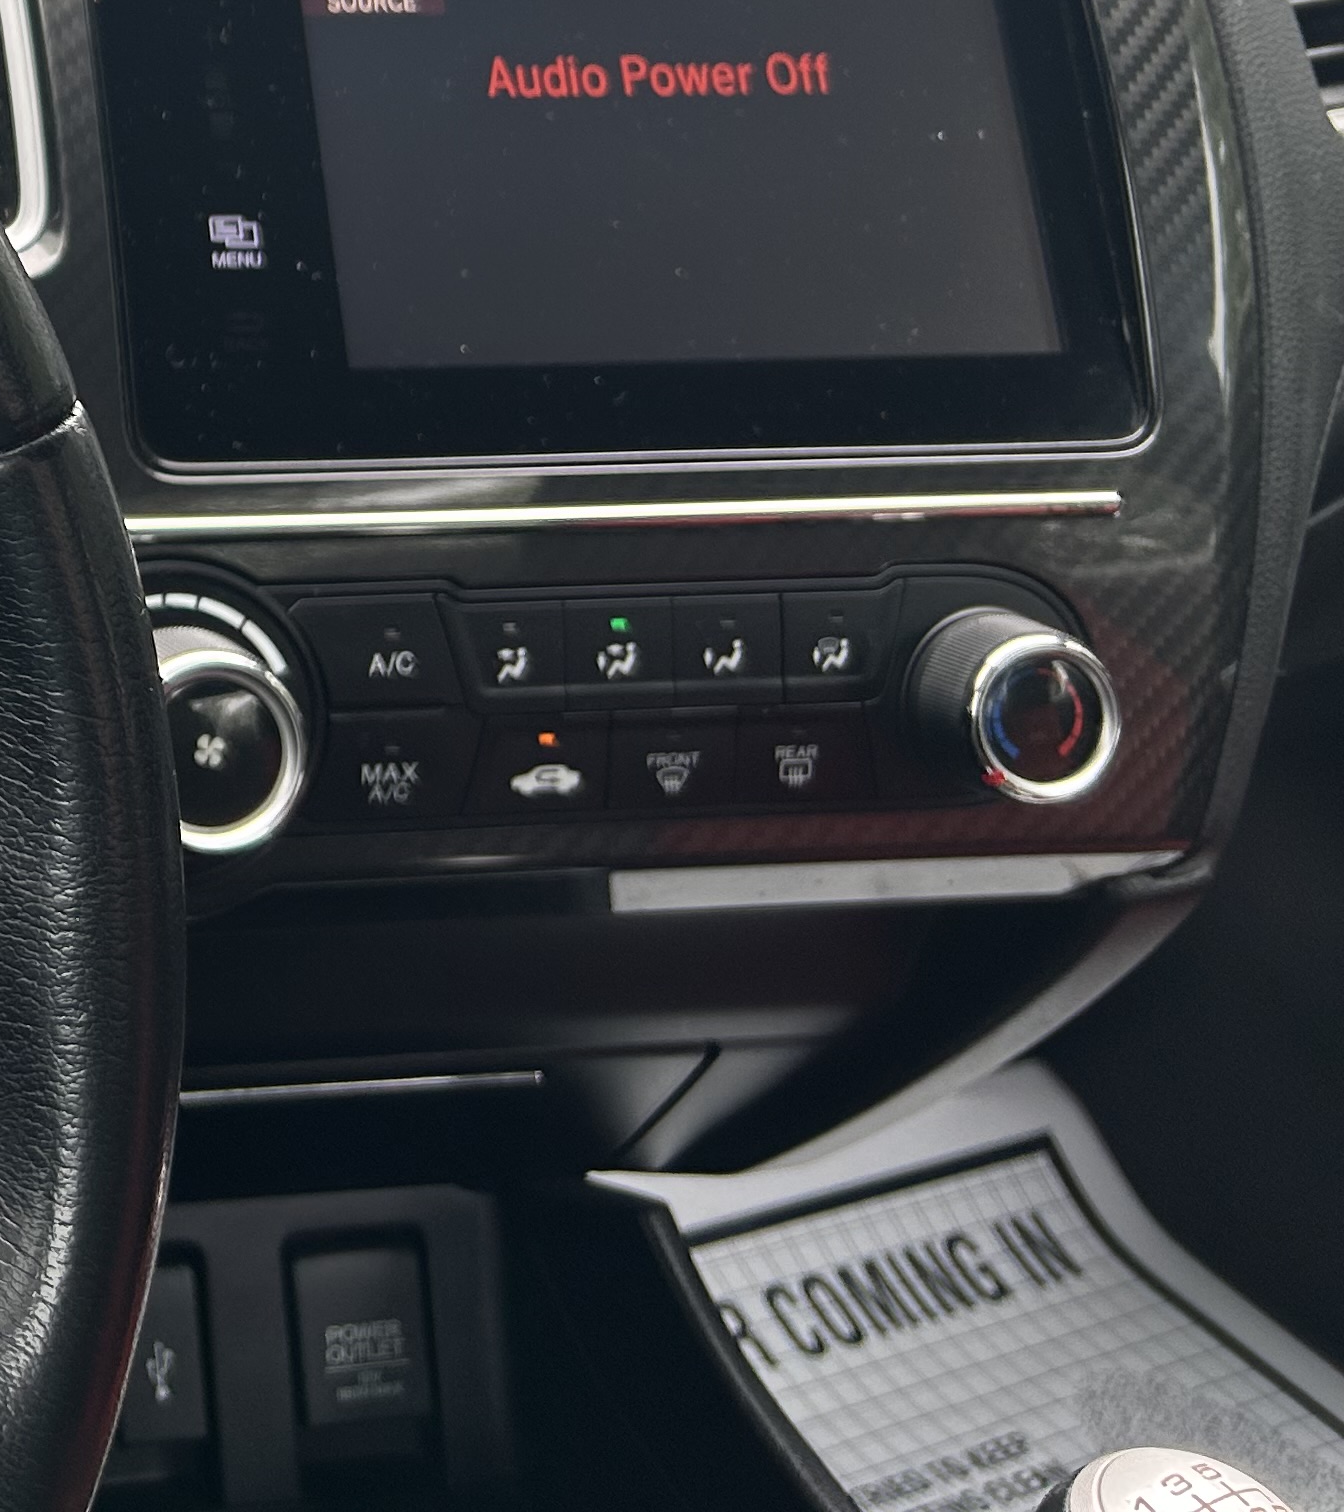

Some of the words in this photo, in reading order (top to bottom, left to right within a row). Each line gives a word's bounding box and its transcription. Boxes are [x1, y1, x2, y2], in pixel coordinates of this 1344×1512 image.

[487, 54, 609, 99] Audio
[618, 53, 753, 98] Power
[765, 51, 829, 96] Off
[212, 250, 264, 269] MENU
[368, 649, 417, 679] A/C
[646, 750, 700, 771] FRONT
[774, 743, 819, 762] REAR
[361, 761, 420, 786] MAX
[367, 781, 412, 806] A/C
[764, 1231, 1012, 1355] COMING
[992, 1210, 1085, 1288] IN
[325, 1319, 402, 1346] POWER
[325, 1339, 408, 1365] OUTLET
[1161, 1473, 1193, 1495] 3
[1192, 1463, 1221, 1480] 5
